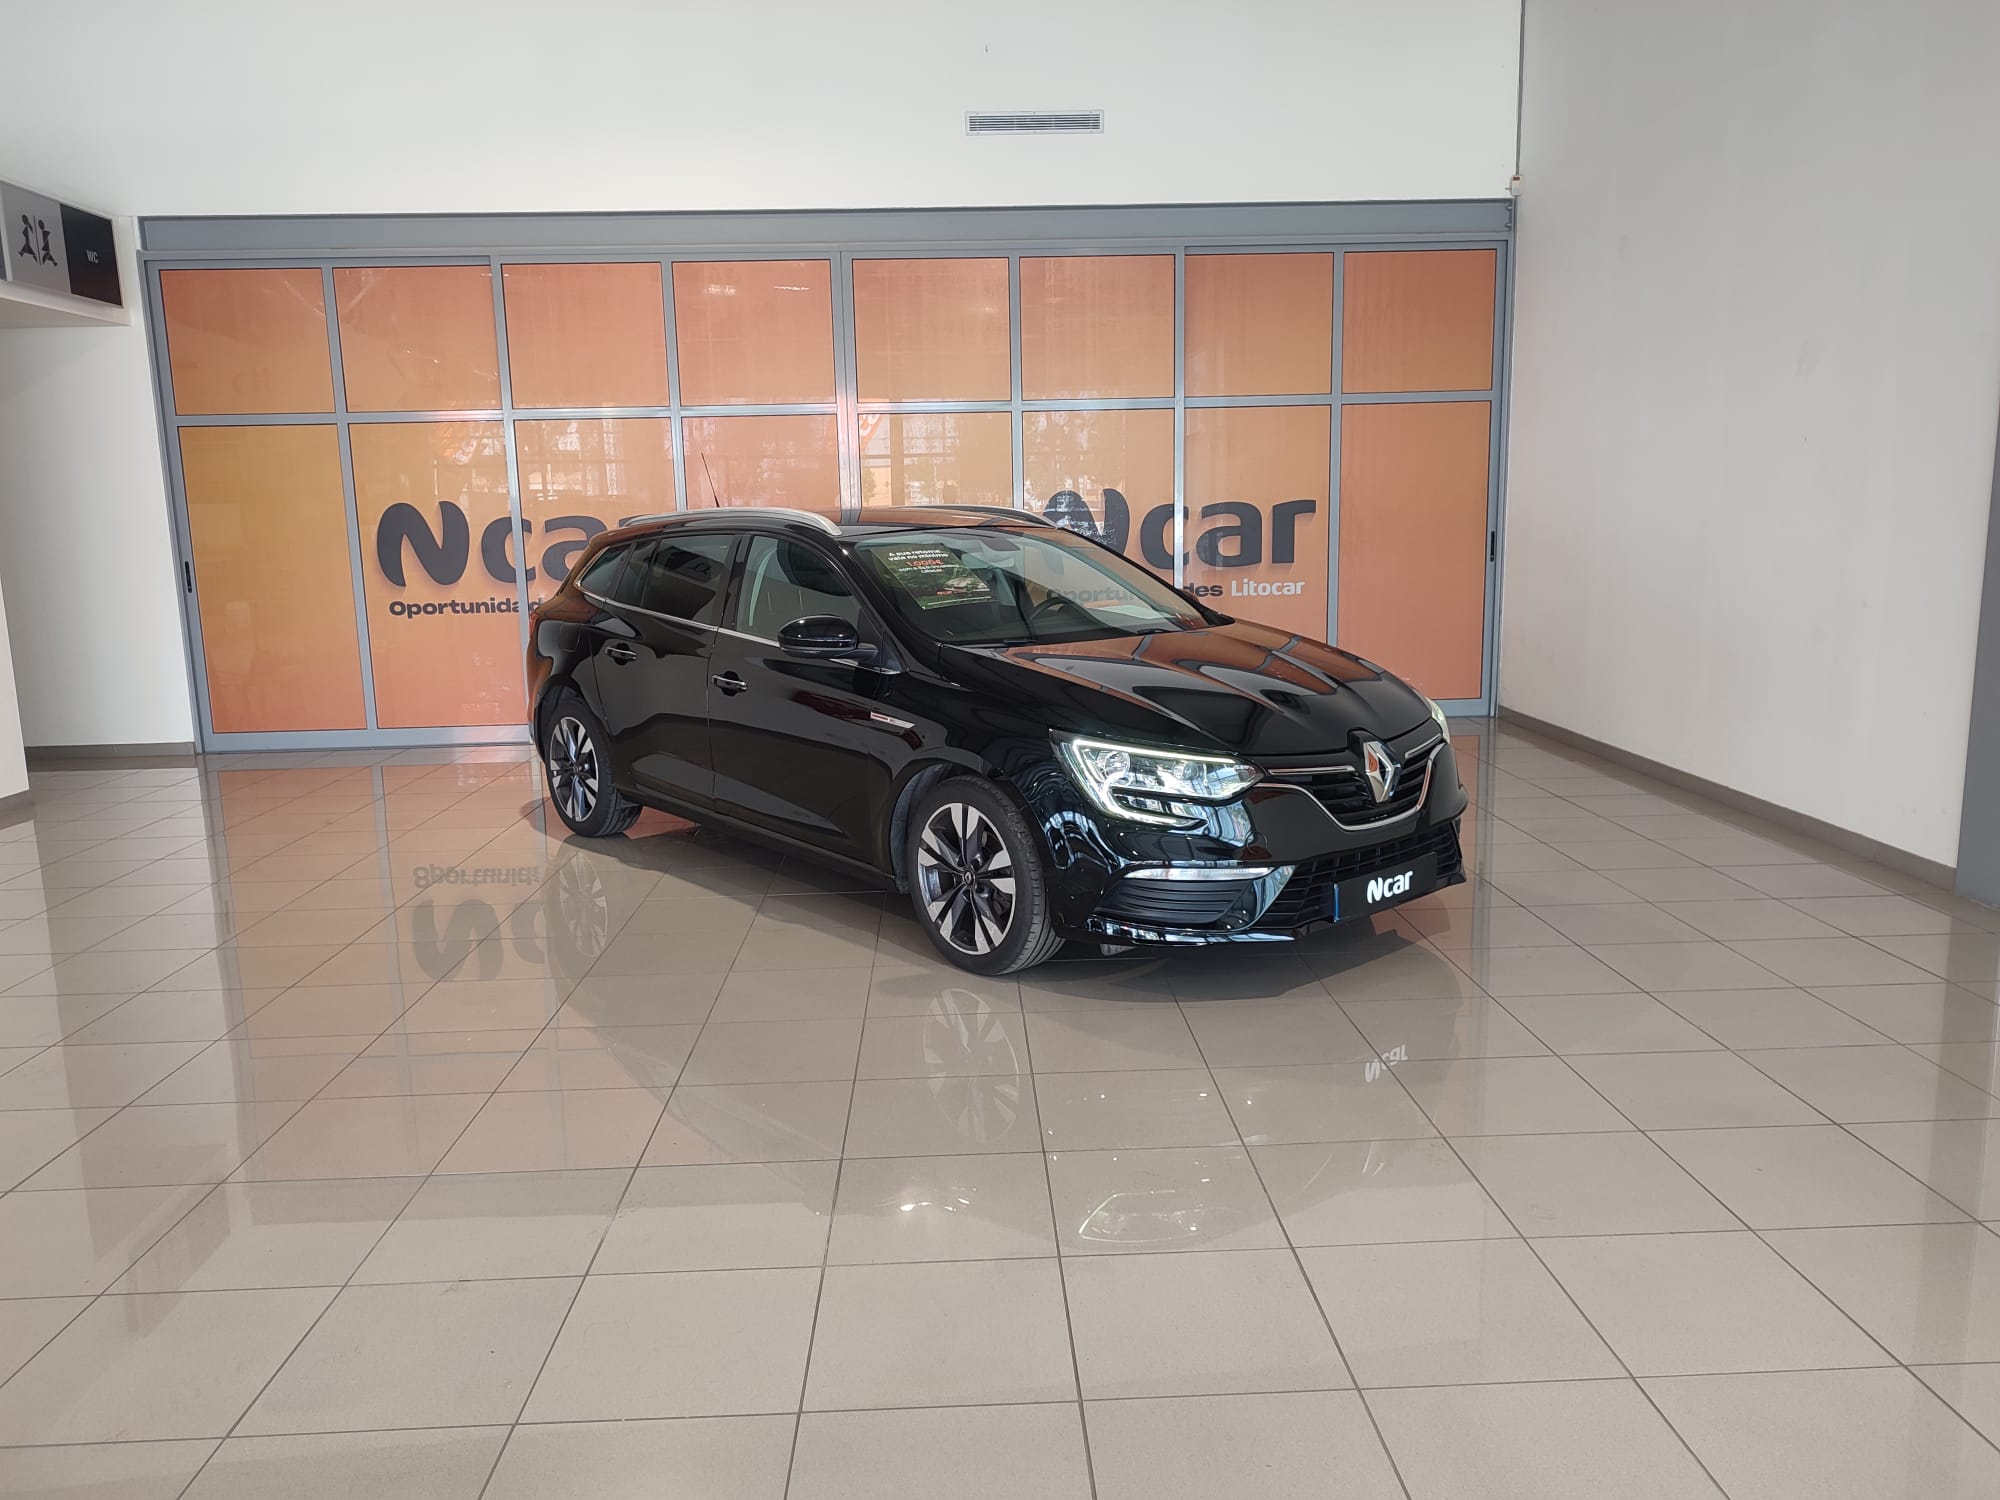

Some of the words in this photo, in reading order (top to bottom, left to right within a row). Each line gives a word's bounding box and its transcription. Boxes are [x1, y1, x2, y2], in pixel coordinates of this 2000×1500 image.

[86, 249, 99, 264] WC
[376, 500, 650, 588] Nca
[1231, 579, 1305, 597] Litocar
[1366, 870, 1413, 904] Ncar
